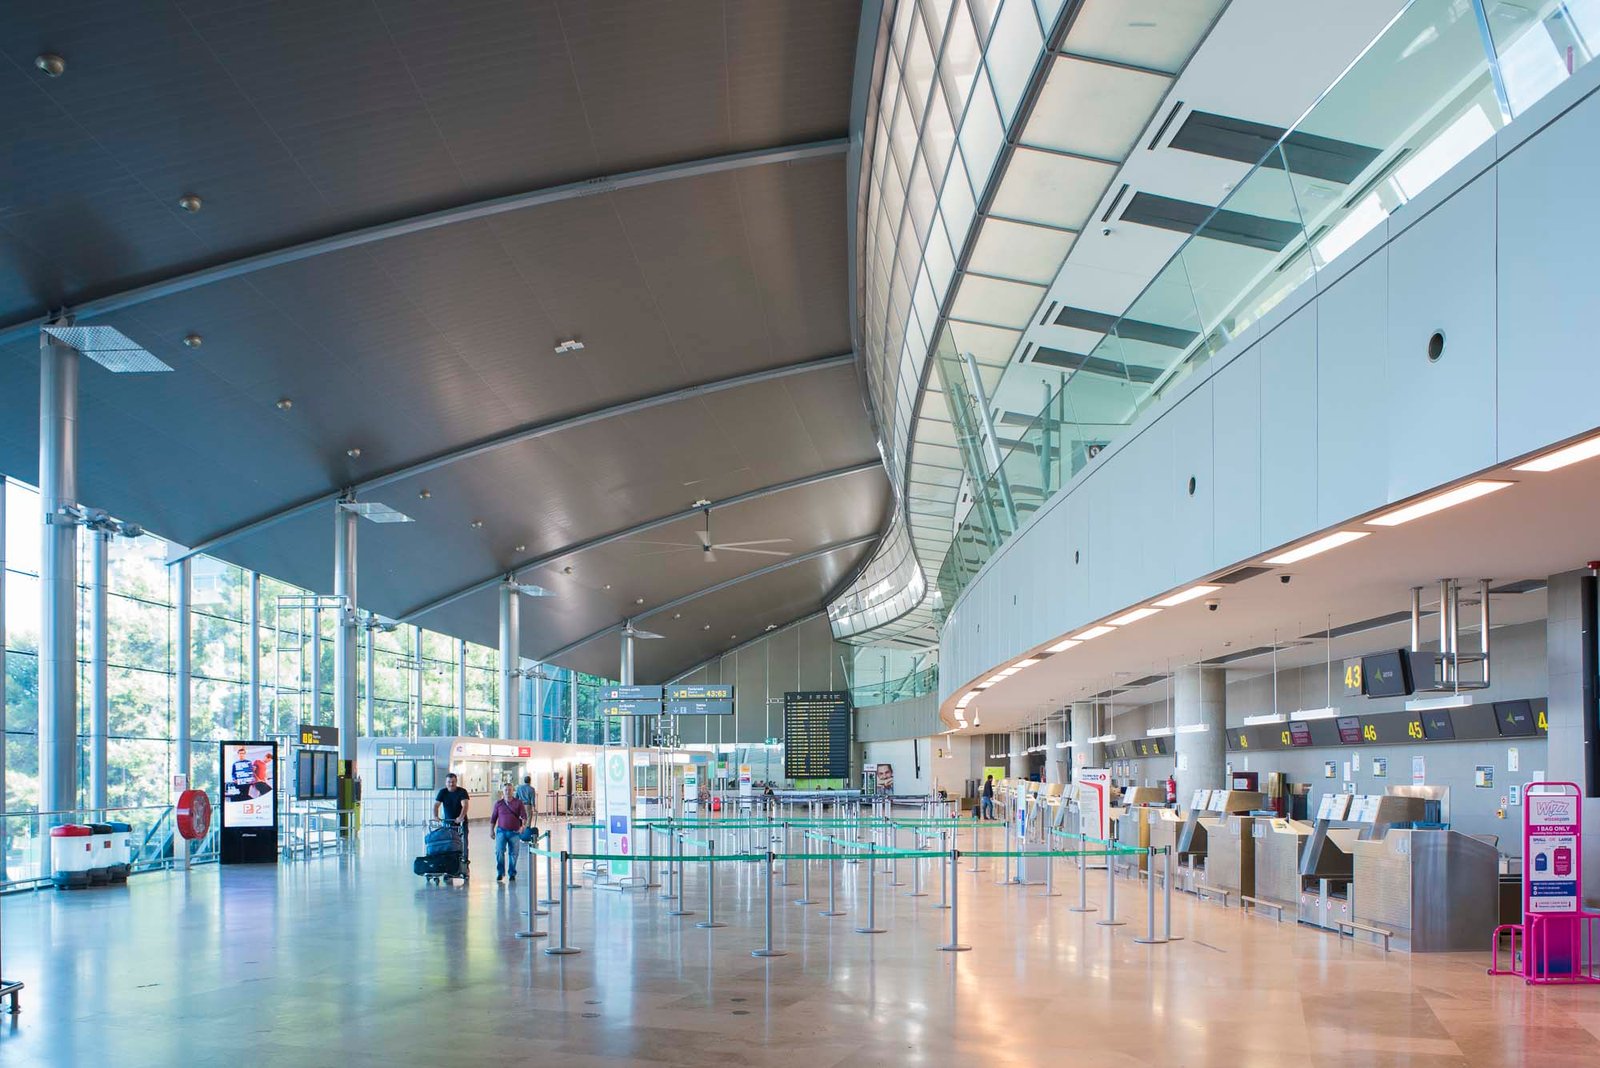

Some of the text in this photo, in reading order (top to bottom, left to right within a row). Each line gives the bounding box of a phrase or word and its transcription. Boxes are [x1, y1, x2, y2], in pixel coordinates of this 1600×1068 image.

[1345, 665, 1360, 688] 43
[706, 690, 727, 698] 43:63
[1364, 724, 1377, 741] 46
[1408, 722, 1422, 738] 45
[1240, 734, 1248, 748] 48
[1281, 731, 1290, 745] 47
